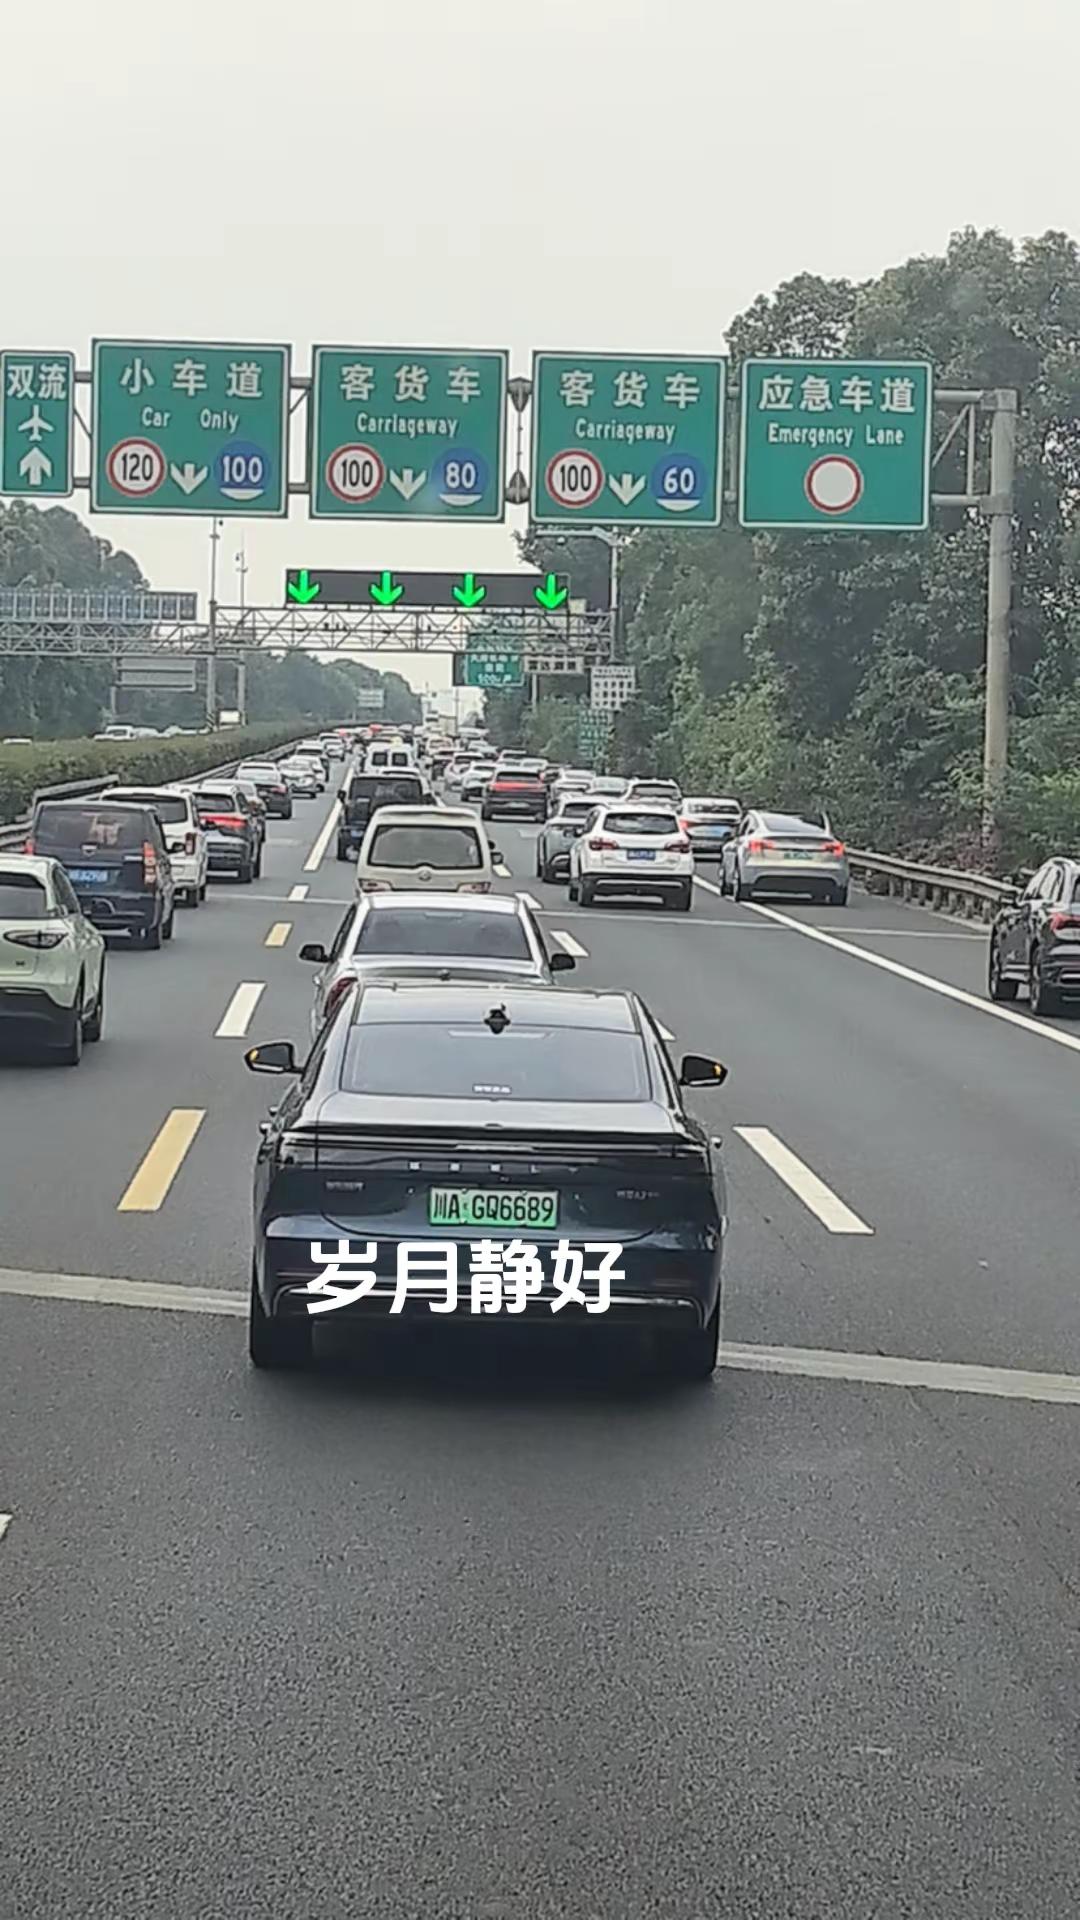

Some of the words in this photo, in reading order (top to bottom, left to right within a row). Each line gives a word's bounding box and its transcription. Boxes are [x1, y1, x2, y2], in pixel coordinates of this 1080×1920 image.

[7, 364, 67, 400] 双流
[120, 358, 263, 397] 小车道
[340, 364, 481, 402] 客货车
[560, 371, 699, 409] 客货车
[758, 375, 916, 413] 应急车道
[142, 408, 171, 428] Car
[200, 409, 239, 433] Only
[357, 413, 458, 437] Carriageway
[575, 418, 675, 443] Carriageway
[768, 424, 853, 448] Emergency
[866, 424, 904, 446] Lane
[121, 452, 153, 482] 120
[223, 455, 263, 484] 100
[341, 458, 373, 487] 100
[446, 461, 476, 488] 80
[560, 464, 592, 493] 100
[663, 467, 695, 494] 60
